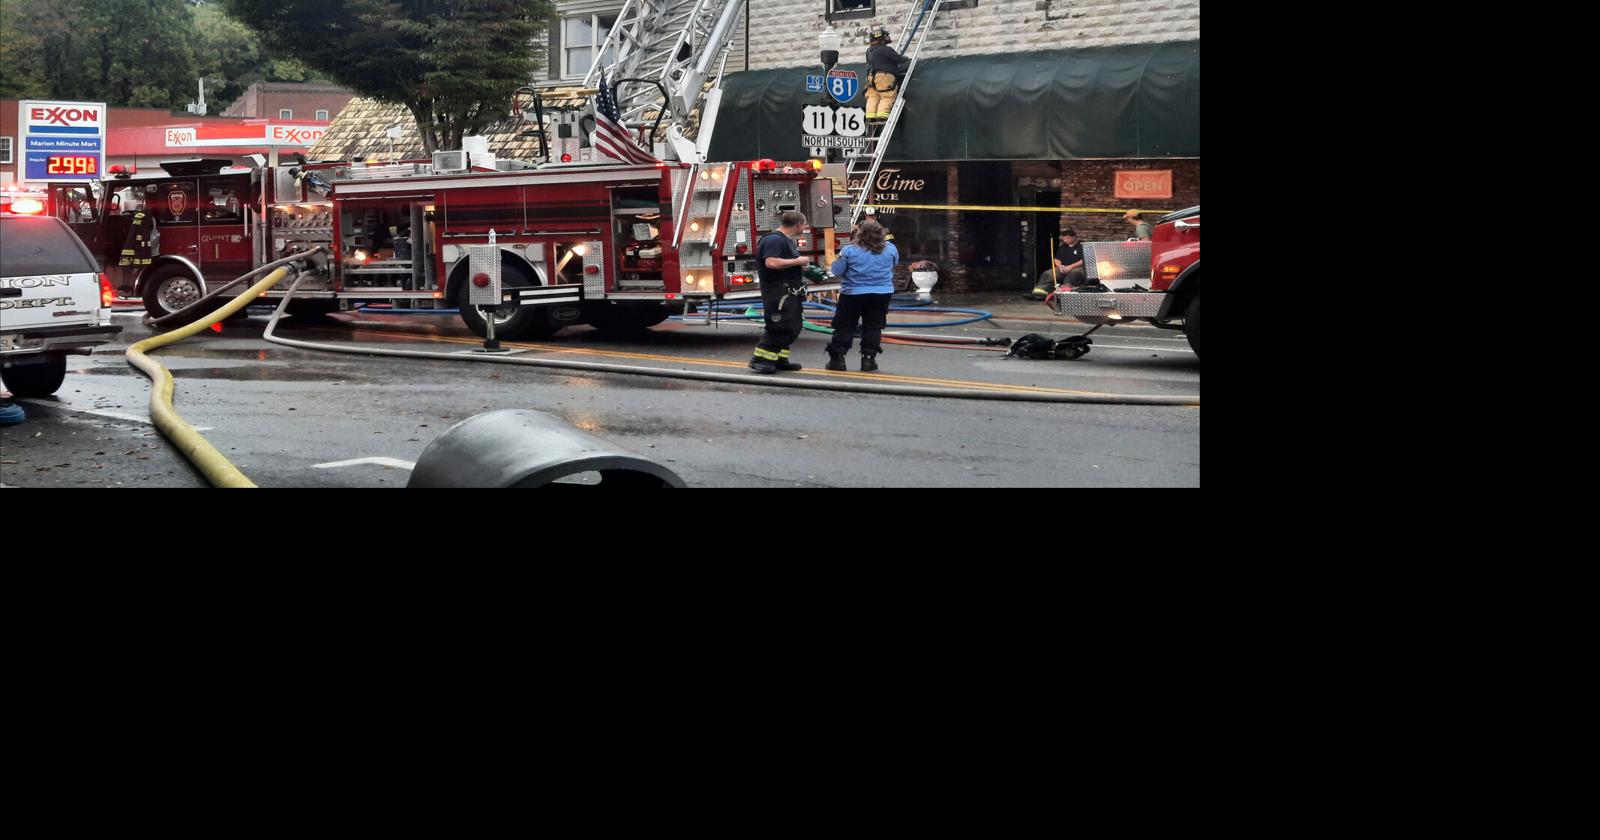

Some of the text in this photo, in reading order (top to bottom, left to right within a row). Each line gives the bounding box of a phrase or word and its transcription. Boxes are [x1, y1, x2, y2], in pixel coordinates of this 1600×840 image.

[832, 78, 852, 96] 81
[31, 107, 98, 126] EXXON
[812, 112, 825, 129] 11
[841, 113, 859, 130] 16
[167, 130, 193, 145] Exxon
[273, 127, 322, 143] Exxon
[804, 136, 833, 146] NORTH
[836, 136, 865, 147] SOUTH
[48, 157, 87, 174] 2.99
[877, 168, 925, 190] Time
[1123, 181, 1162, 191] OPEN
[201, 234, 230, 242] QUINT
